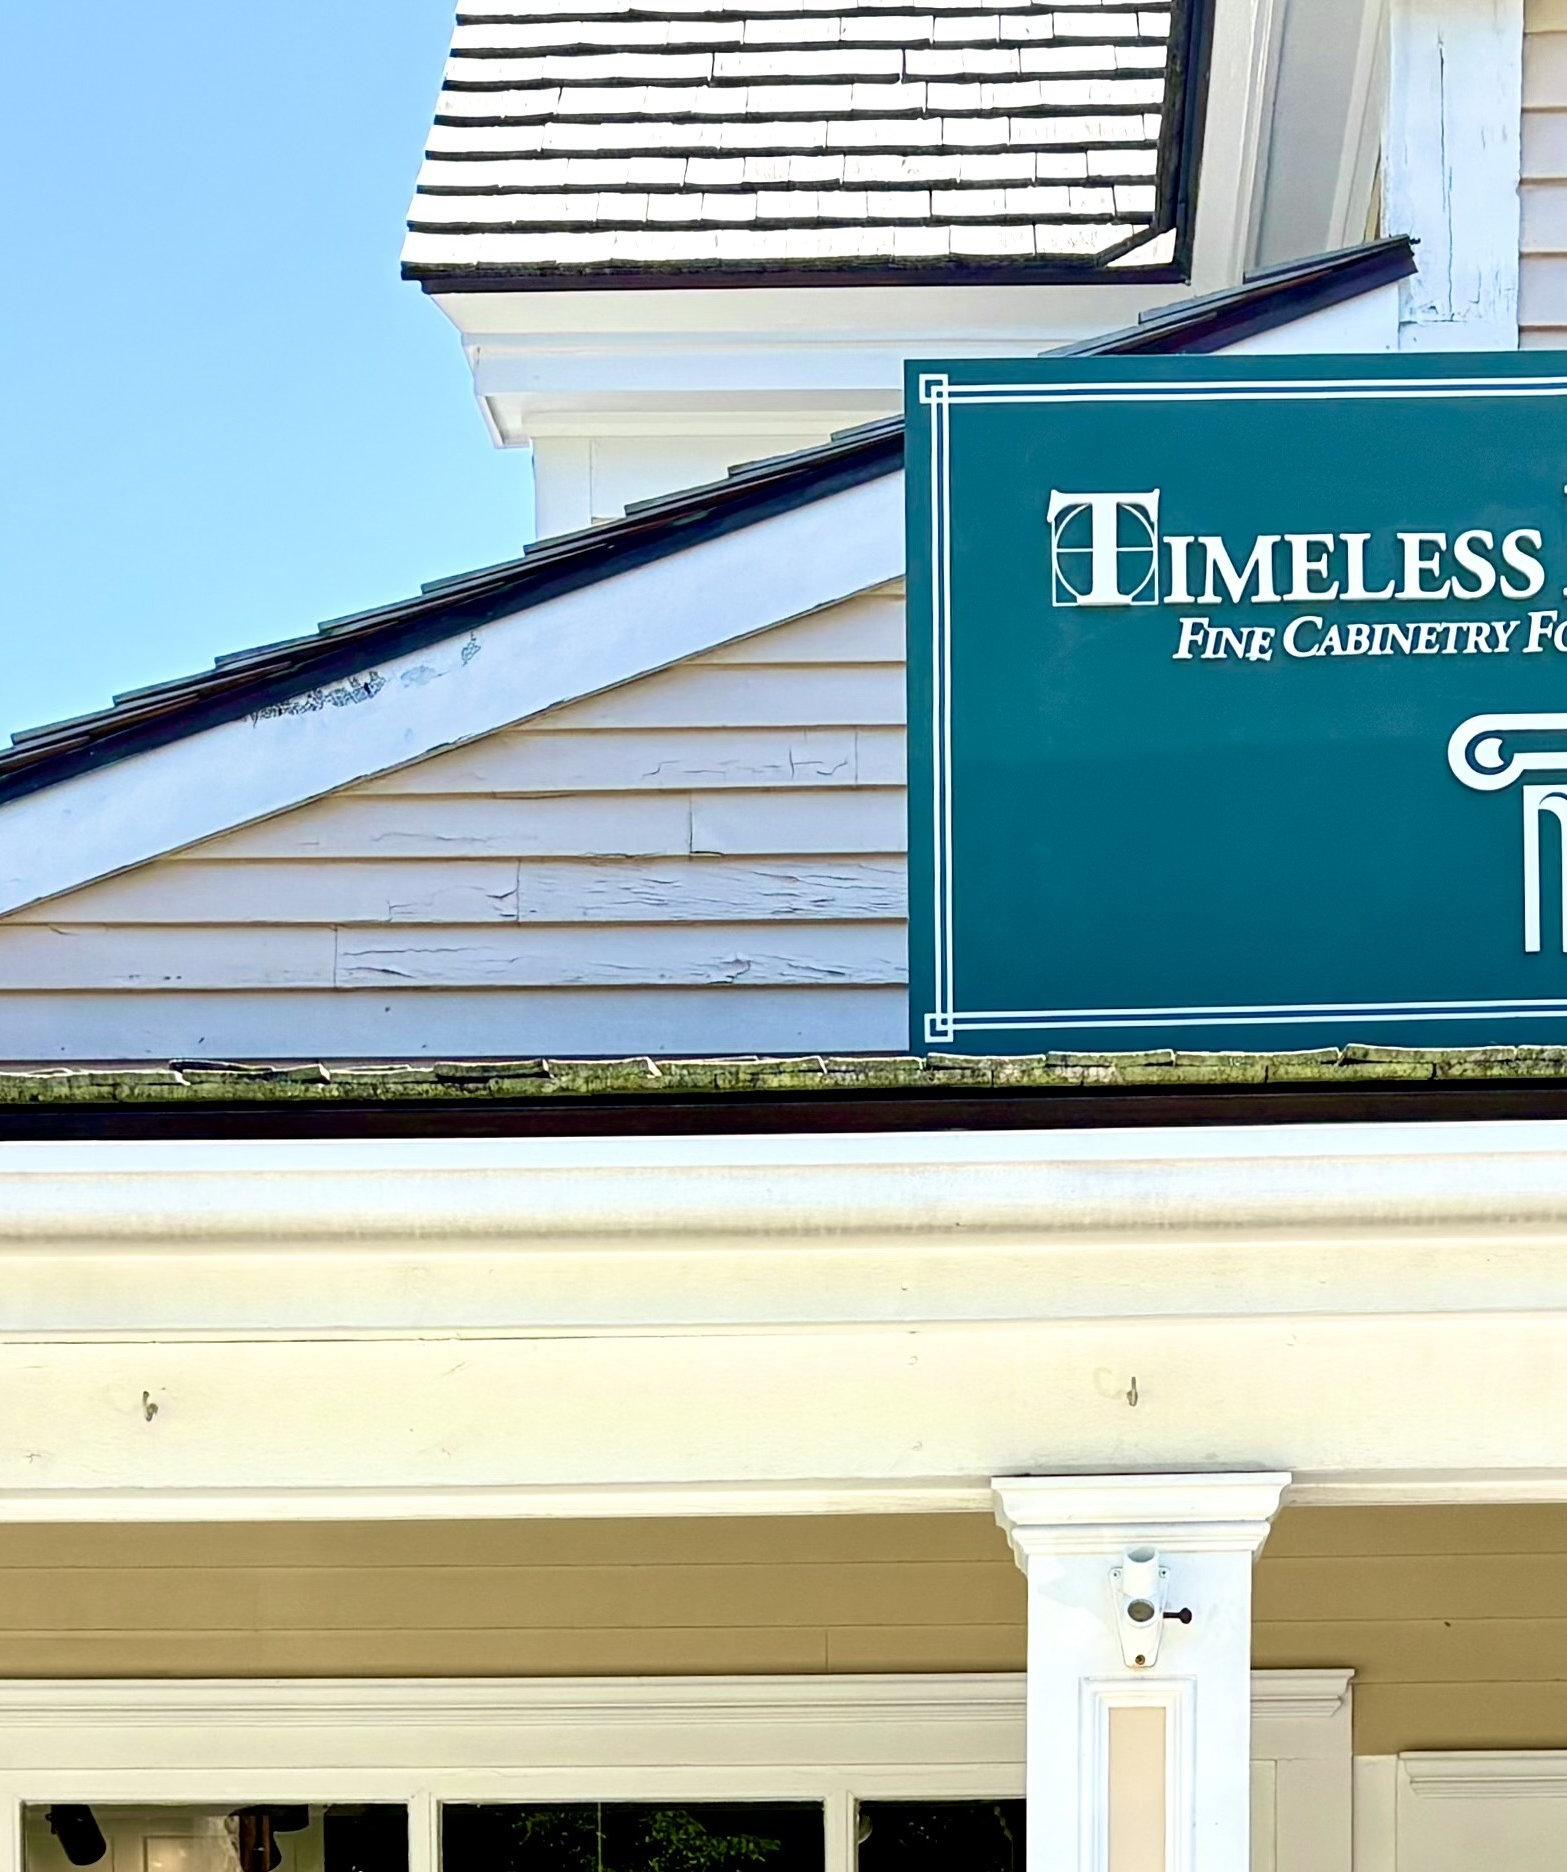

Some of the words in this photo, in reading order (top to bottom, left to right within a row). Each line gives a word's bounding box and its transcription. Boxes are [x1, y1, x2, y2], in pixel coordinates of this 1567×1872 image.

[1046, 487, 1546, 607] TIMELESS
[1172, 616, 1275, 661] FINE
[1282, 615, 1520, 658] CABINETRY
